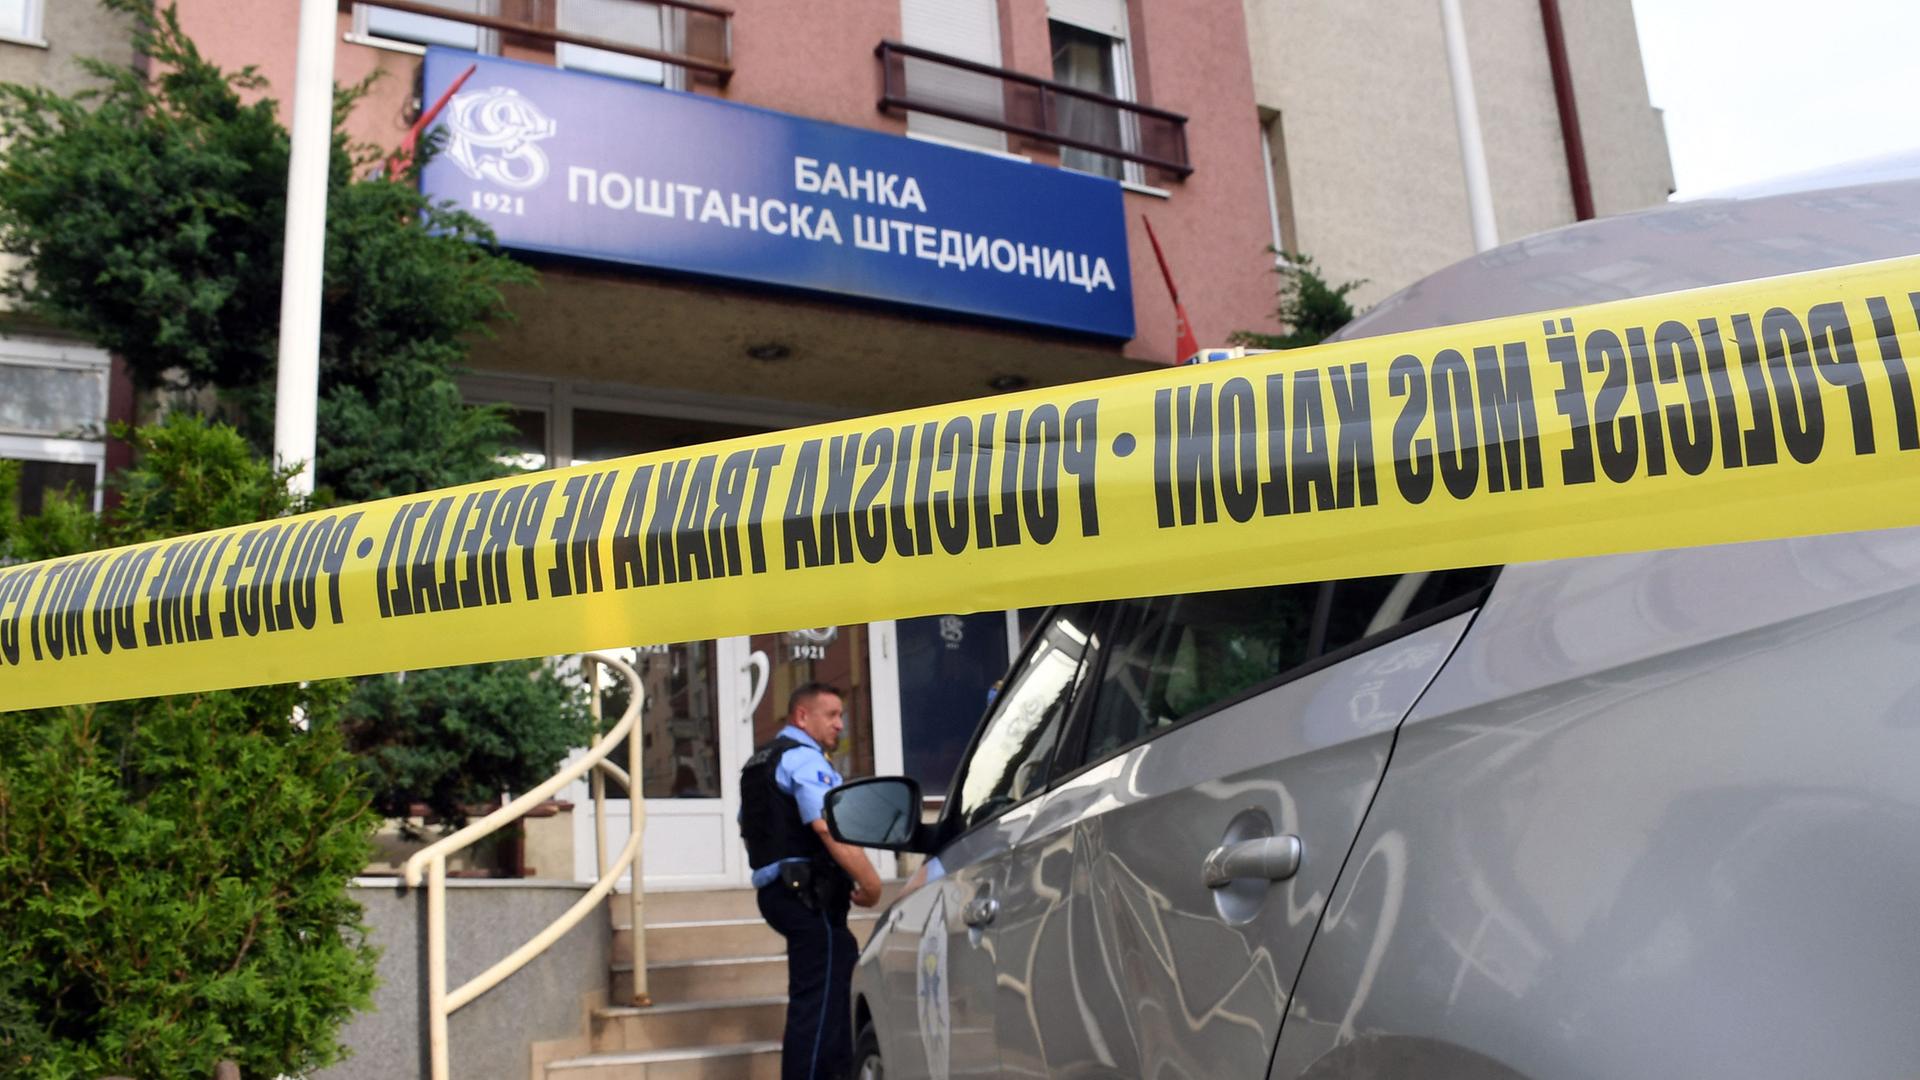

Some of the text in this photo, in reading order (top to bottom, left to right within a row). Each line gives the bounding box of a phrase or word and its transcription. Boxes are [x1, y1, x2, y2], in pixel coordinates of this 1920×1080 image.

[471, 190, 526, 216] 1921
[794, 156, 927, 213] БАНКА
[567, 165, 1116, 293] ПОШТАНСКА ШТЕДИОНИЦА
[793, 645, 825, 660] 1921
